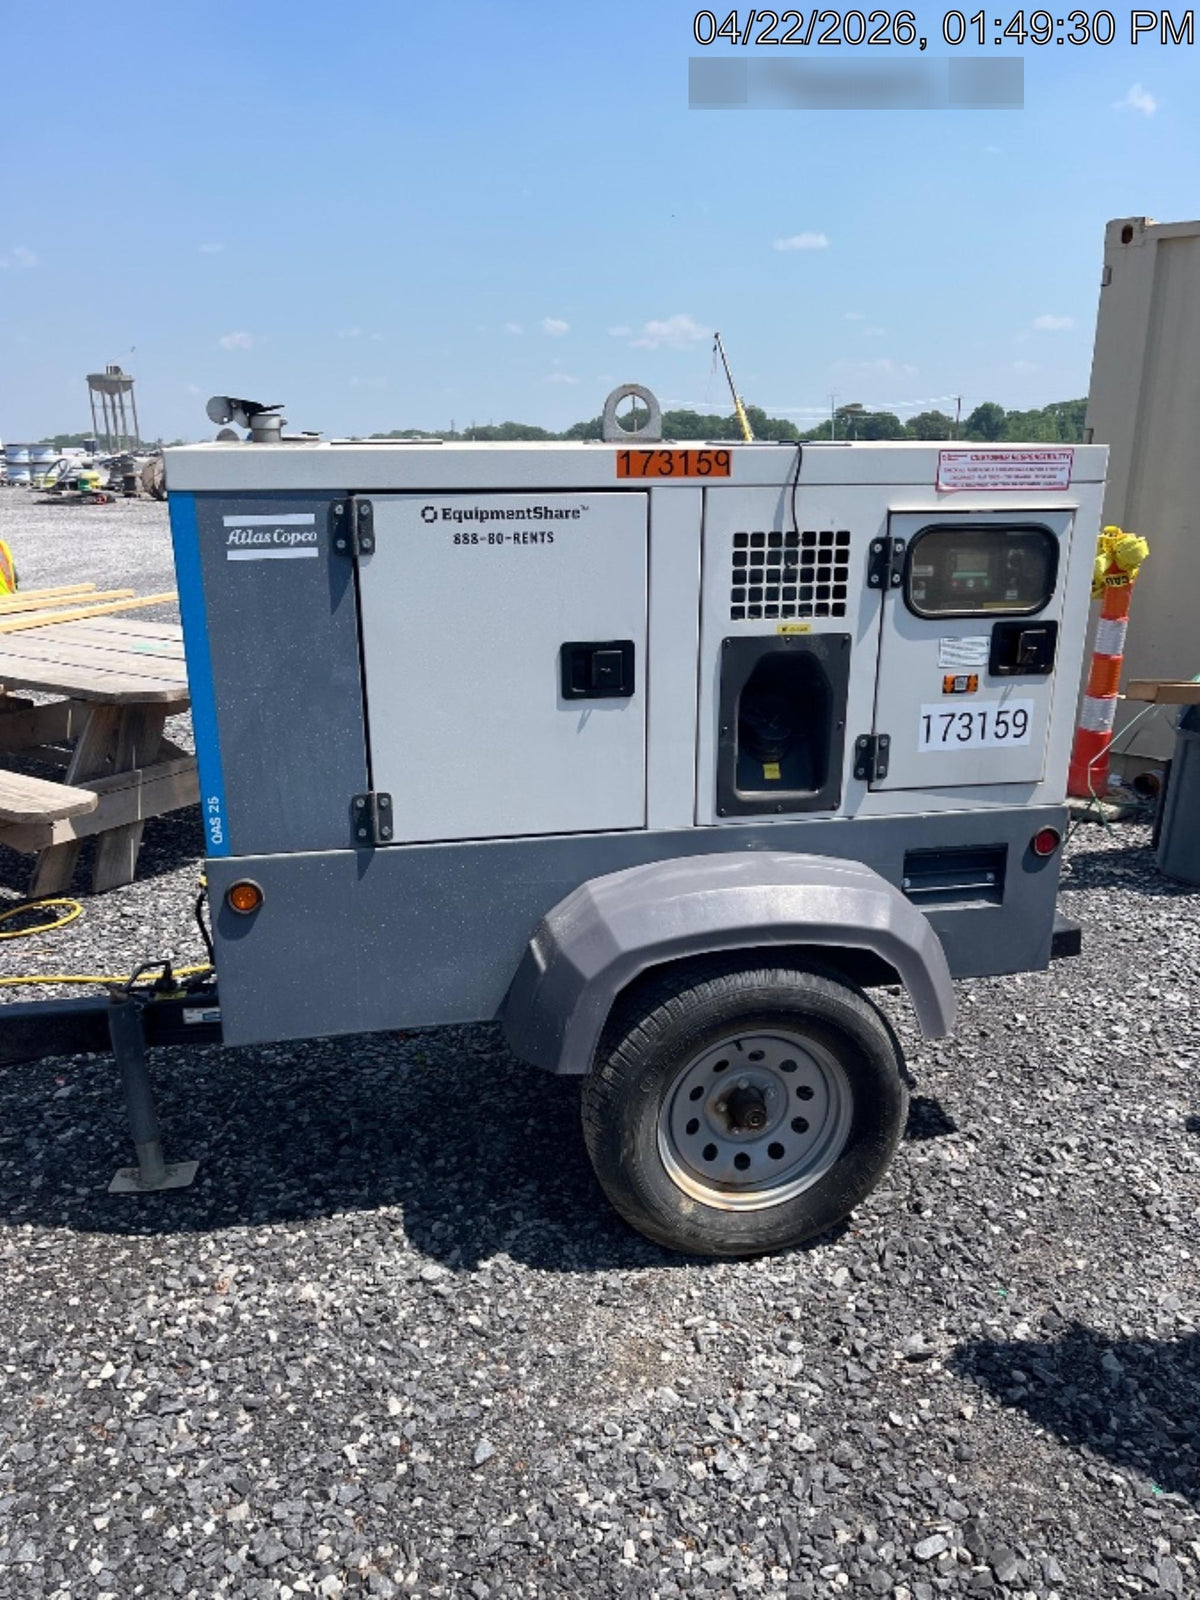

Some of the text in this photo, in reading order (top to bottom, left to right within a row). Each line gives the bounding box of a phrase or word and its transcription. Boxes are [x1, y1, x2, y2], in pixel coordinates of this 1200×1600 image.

[619, 450, 731, 476] 173159
[225, 528, 318, 545] Atlas Copco
[452, 531, 555, 545] 888-80-RENTS
[922, 708, 1028, 744] 173159
[209, 817, 223, 844] QAS
